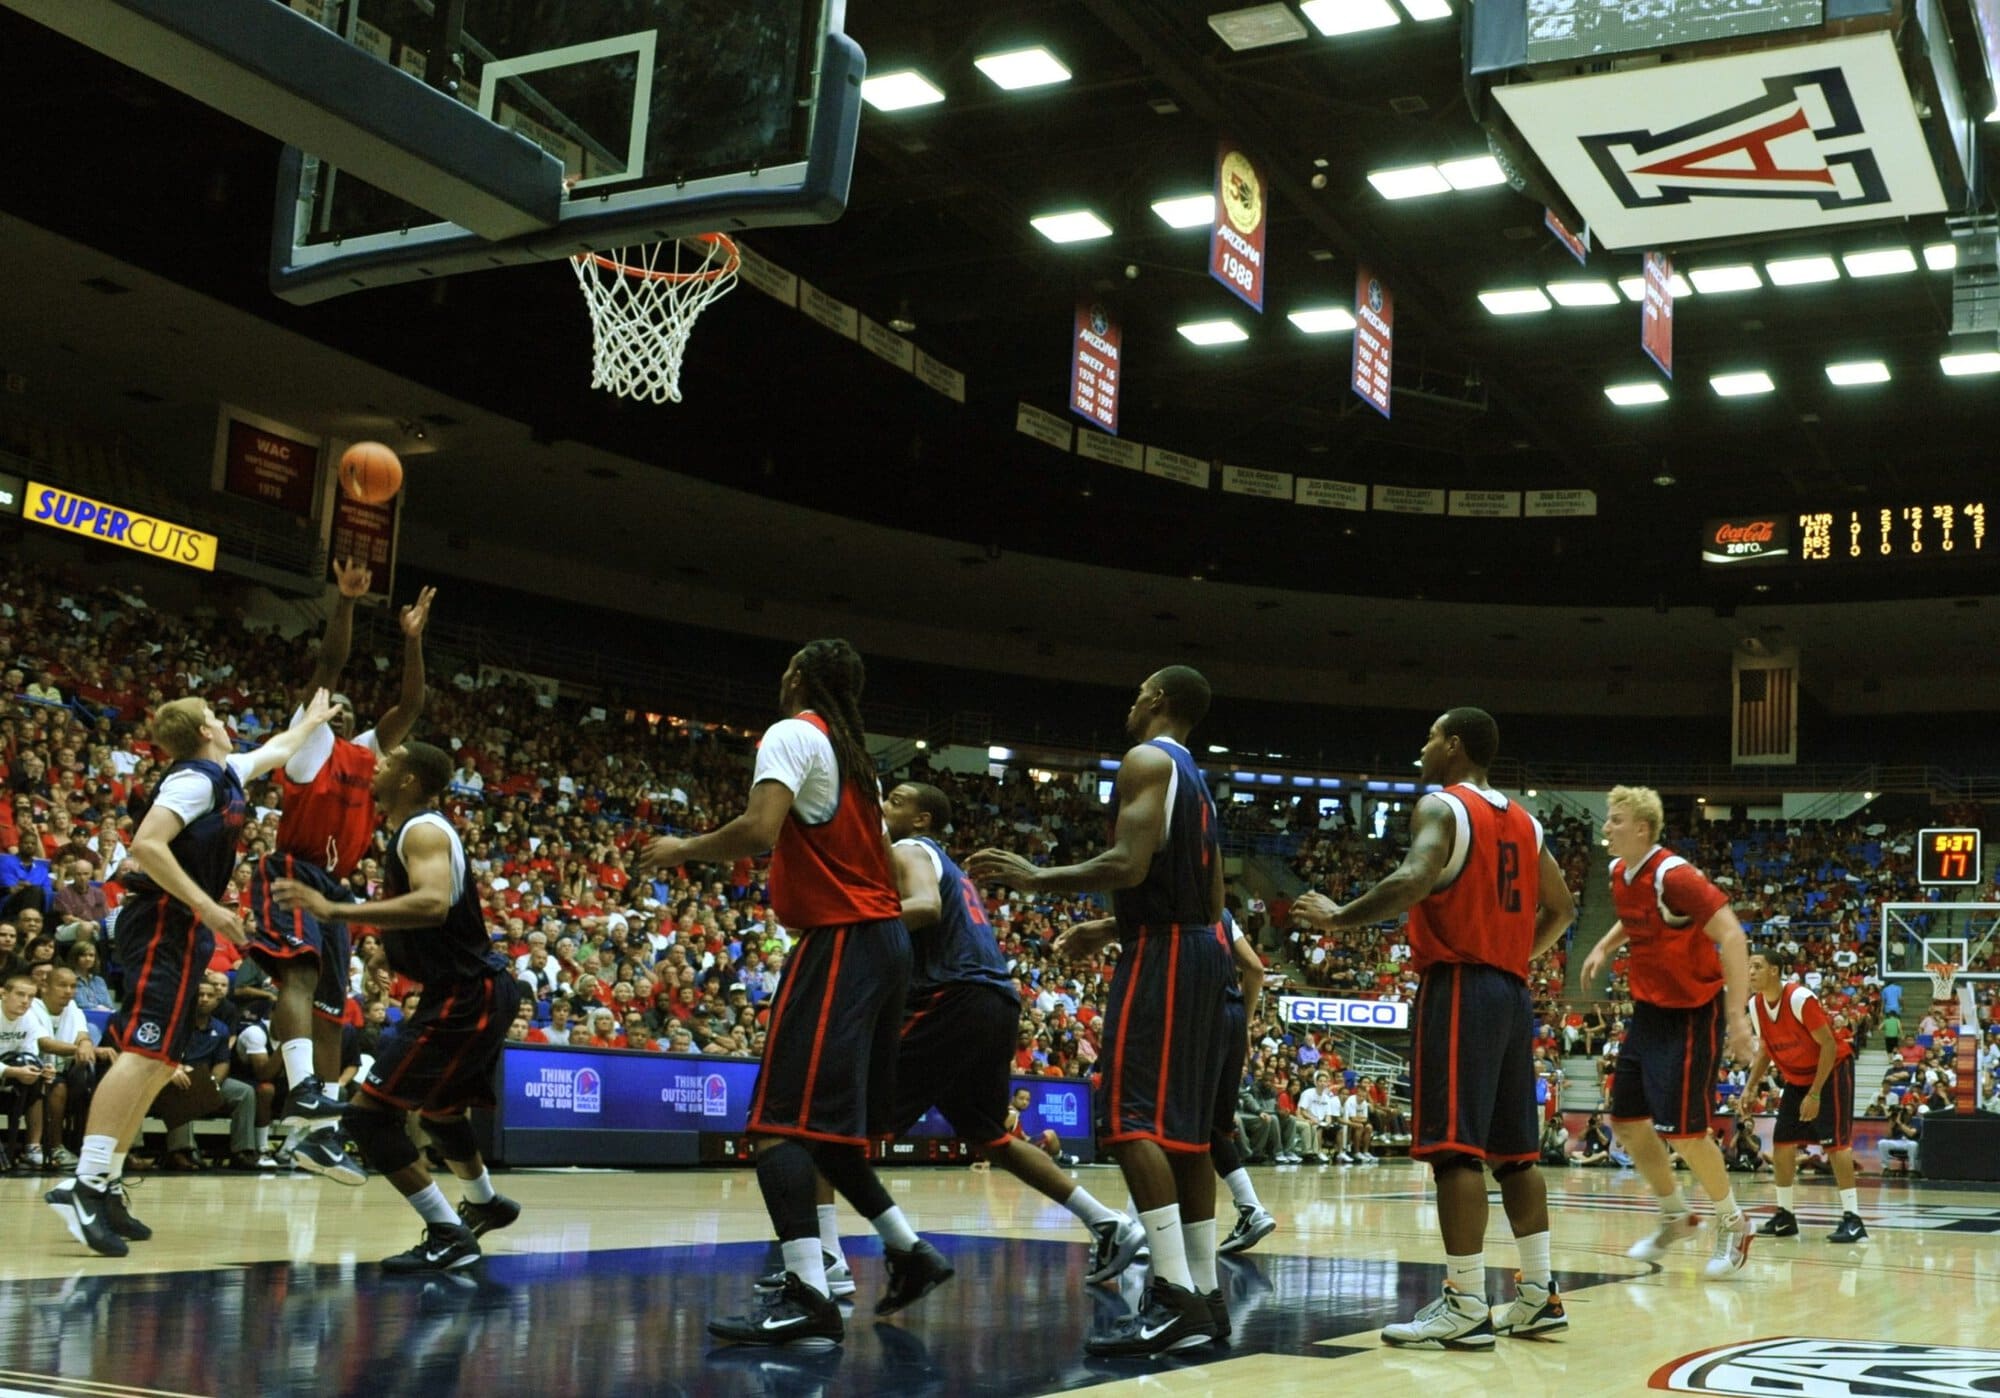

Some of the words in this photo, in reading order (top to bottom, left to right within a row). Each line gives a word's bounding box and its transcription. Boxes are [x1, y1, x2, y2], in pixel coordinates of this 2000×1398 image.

[1217, 224, 1260, 267] ARIZONA
[1222, 253, 1253, 291] 1988
[1359, 304, 1390, 340] ARIZONA
[1079, 328, 1118, 360] ARIZONA
[1359, 328, 1380, 352] SWEET
[1079, 351, 1104, 373] SWEET
[1106, 367, 1115, 380] 16
[257, 438, 290, 460] WAC
[1800, 513, 1832, 527] PLYR
[1851, 511, 1858, 521] 1
[1881, 509, 1891, 521] 2
[1903, 507, 1922, 520] 12
[1933, 505, 1953, 518] 33
[1964, 503, 1985, 516] 44
[1805, 525, 1829, 537] PTS
[1850, 522, 1861, 534] 0
[1942, 517, 1953, 529] 2
[1974, 515, 1985, 527] 2
[35, 490, 202, 563] SUPERCUTS
[1803, 536, 1830, 548] RBS
[1974, 526, 1985, 538] 3
[1803, 547, 1830, 560] FLS
[1850, 544, 1861, 557] 0
[1881, 542, 1891, 555] 0
[1911, 541, 1922, 553] 0
[1942, 539, 1953, 551] 0
[1935, 835, 1974, 852] 5:37
[1941, 854, 1967, 877] 17
[1292, 1000, 1396, 1025] GEICO
[540, 1068, 573, 1083] THINK
[674, 1075, 703, 1088] THINK
[525, 1082, 572, 1097] OUTSIDE
[661, 1088, 703, 1102] OUTSIDE
[540, 1097, 555, 1109] THE
